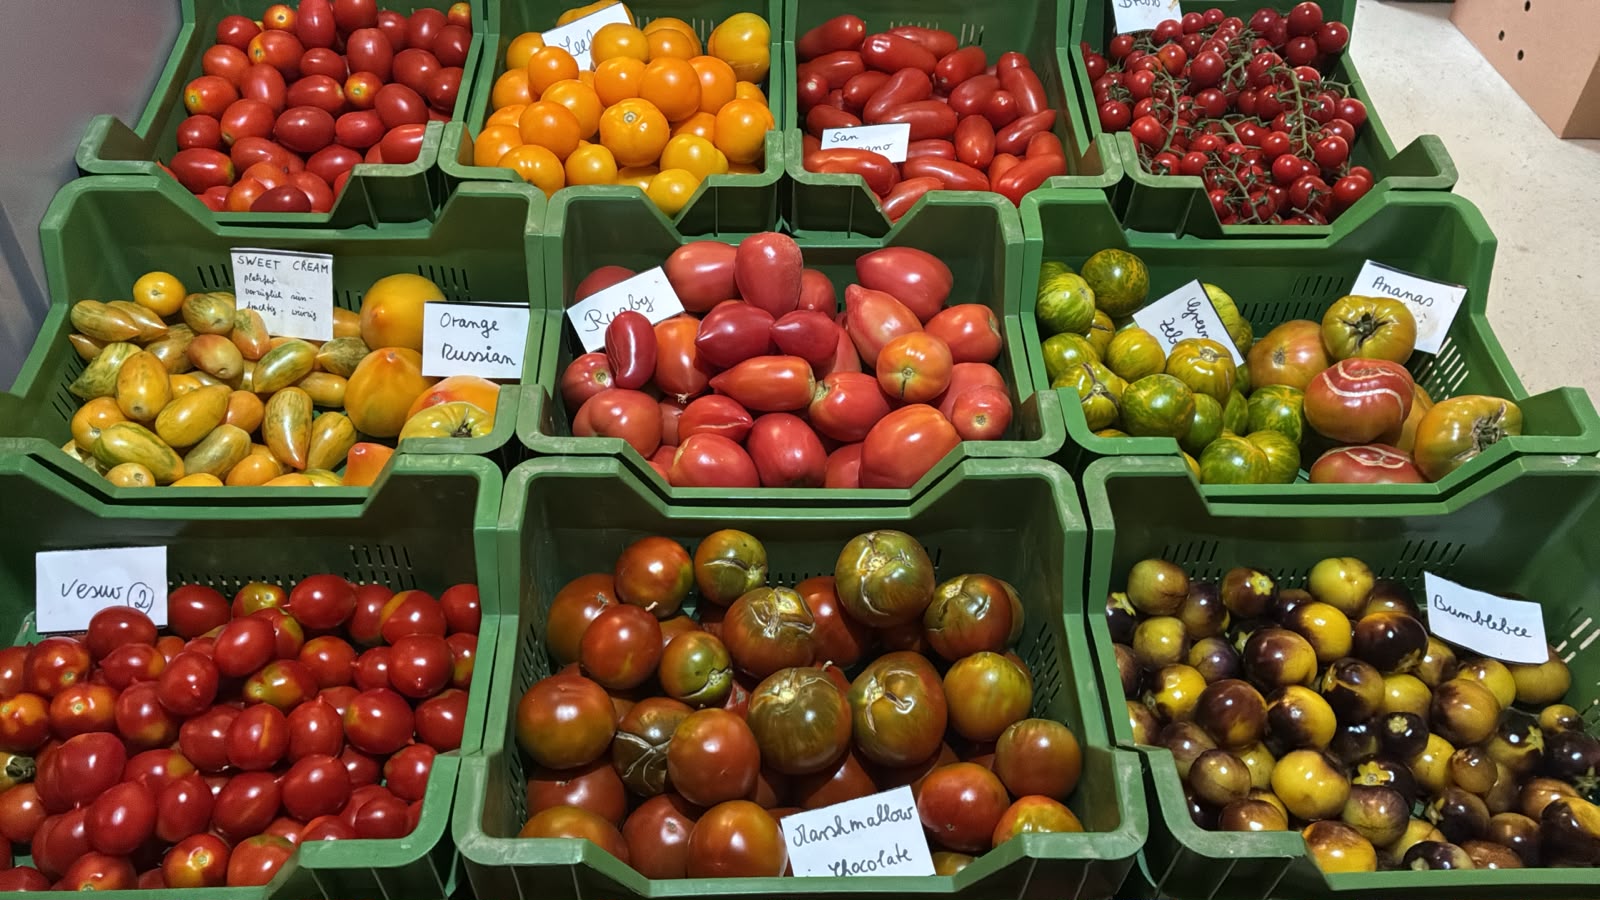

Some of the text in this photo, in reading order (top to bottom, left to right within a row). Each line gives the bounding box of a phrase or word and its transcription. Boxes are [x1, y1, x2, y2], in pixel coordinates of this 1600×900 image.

[830, 131, 859, 143] San
[237, 255, 329, 274] SWEET CREAM
[1371, 276, 1434, 307] Ananas
[440, 312, 499, 338] Orange
[1159, 317, 1184, 345] Zeb
[441, 343, 516, 366] Russian
[1434, 594, 1532, 638] Bumblebee
[793, 803, 914, 847] Marshmallow
[828, 843, 912, 877] Chocolate
